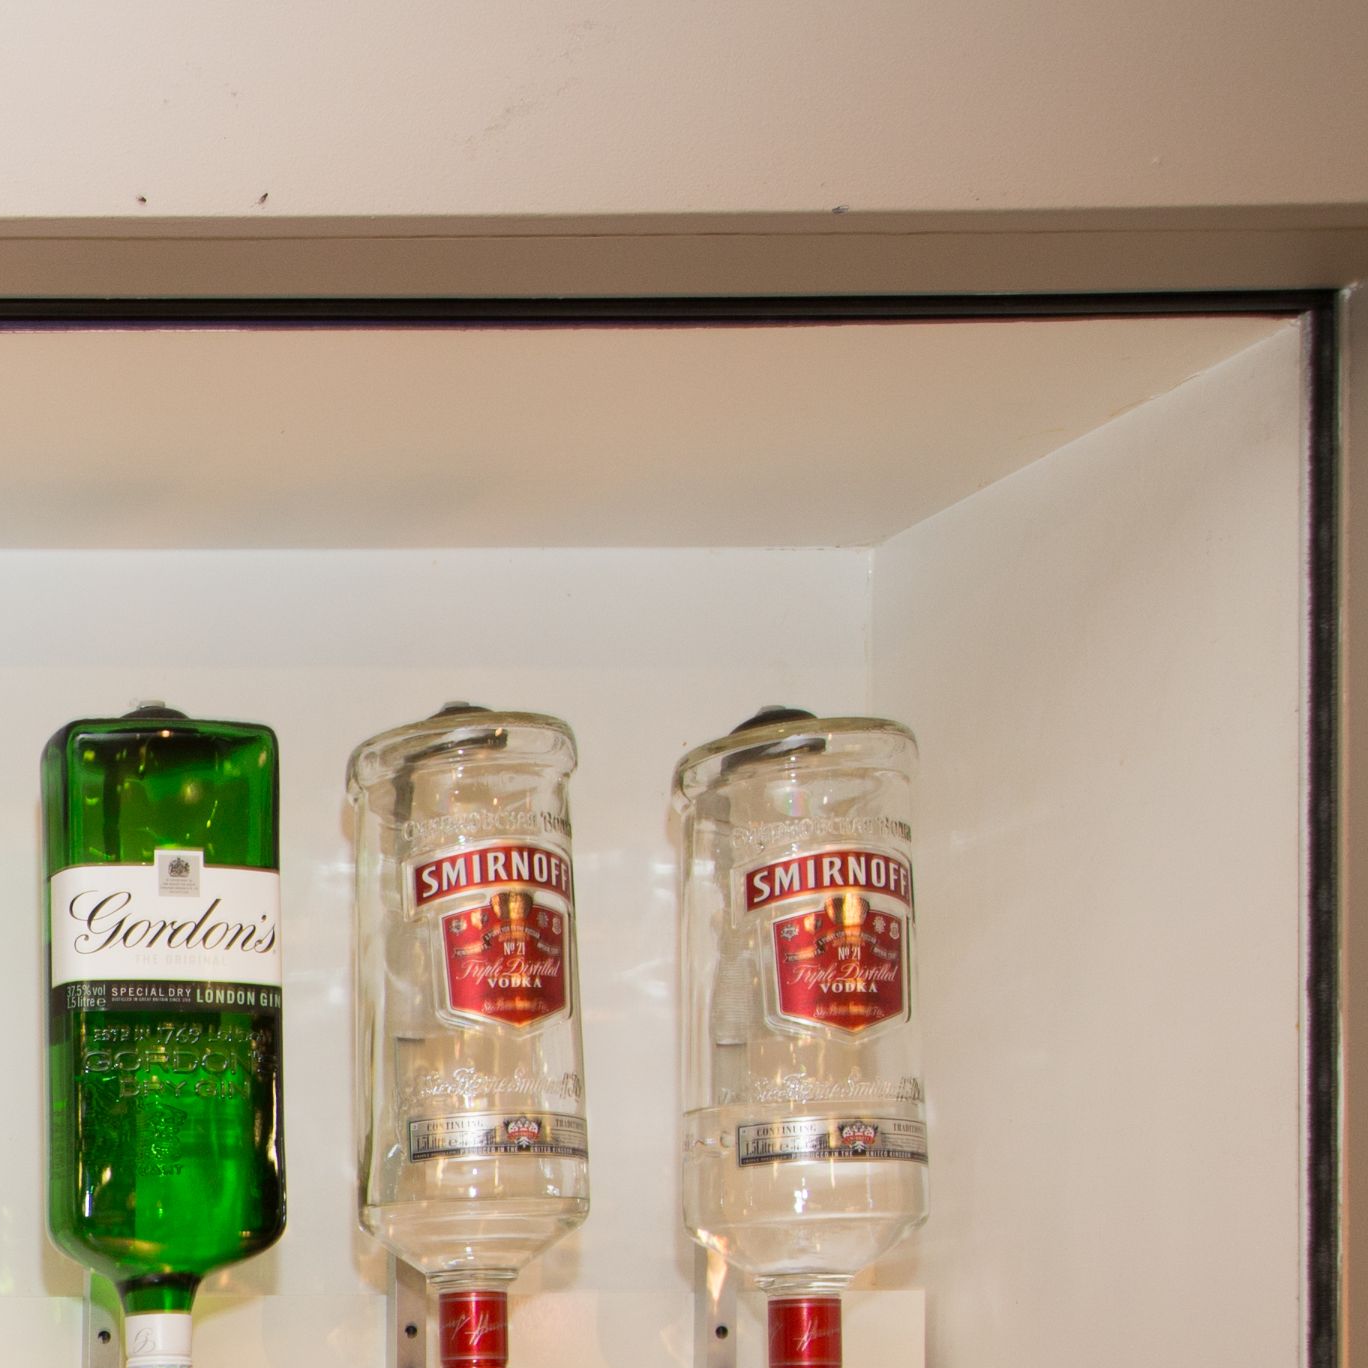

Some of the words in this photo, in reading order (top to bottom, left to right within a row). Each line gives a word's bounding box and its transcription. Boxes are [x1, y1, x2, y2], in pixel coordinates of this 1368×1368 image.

[421, 851, 569, 898] SMIRNOFF
[752, 856, 909, 903] SMIRNOFF
[68, 889, 277, 955] Gordon's
[456, 957, 504, 986] Triple
[504, 957, 561, 978] Distilled
[487, 974, 543, 989] VODKA
[786, 962, 834, 991] Triple
[833, 961, 899, 983] Distilled
[91, 983, 106, 996] vol
[111, 986, 164, 998] SPECIAL
[168, 987, 192, 998] DRY
[195, 989, 256, 1006] LONDON
[819, 981, 879, 994] VODKA
